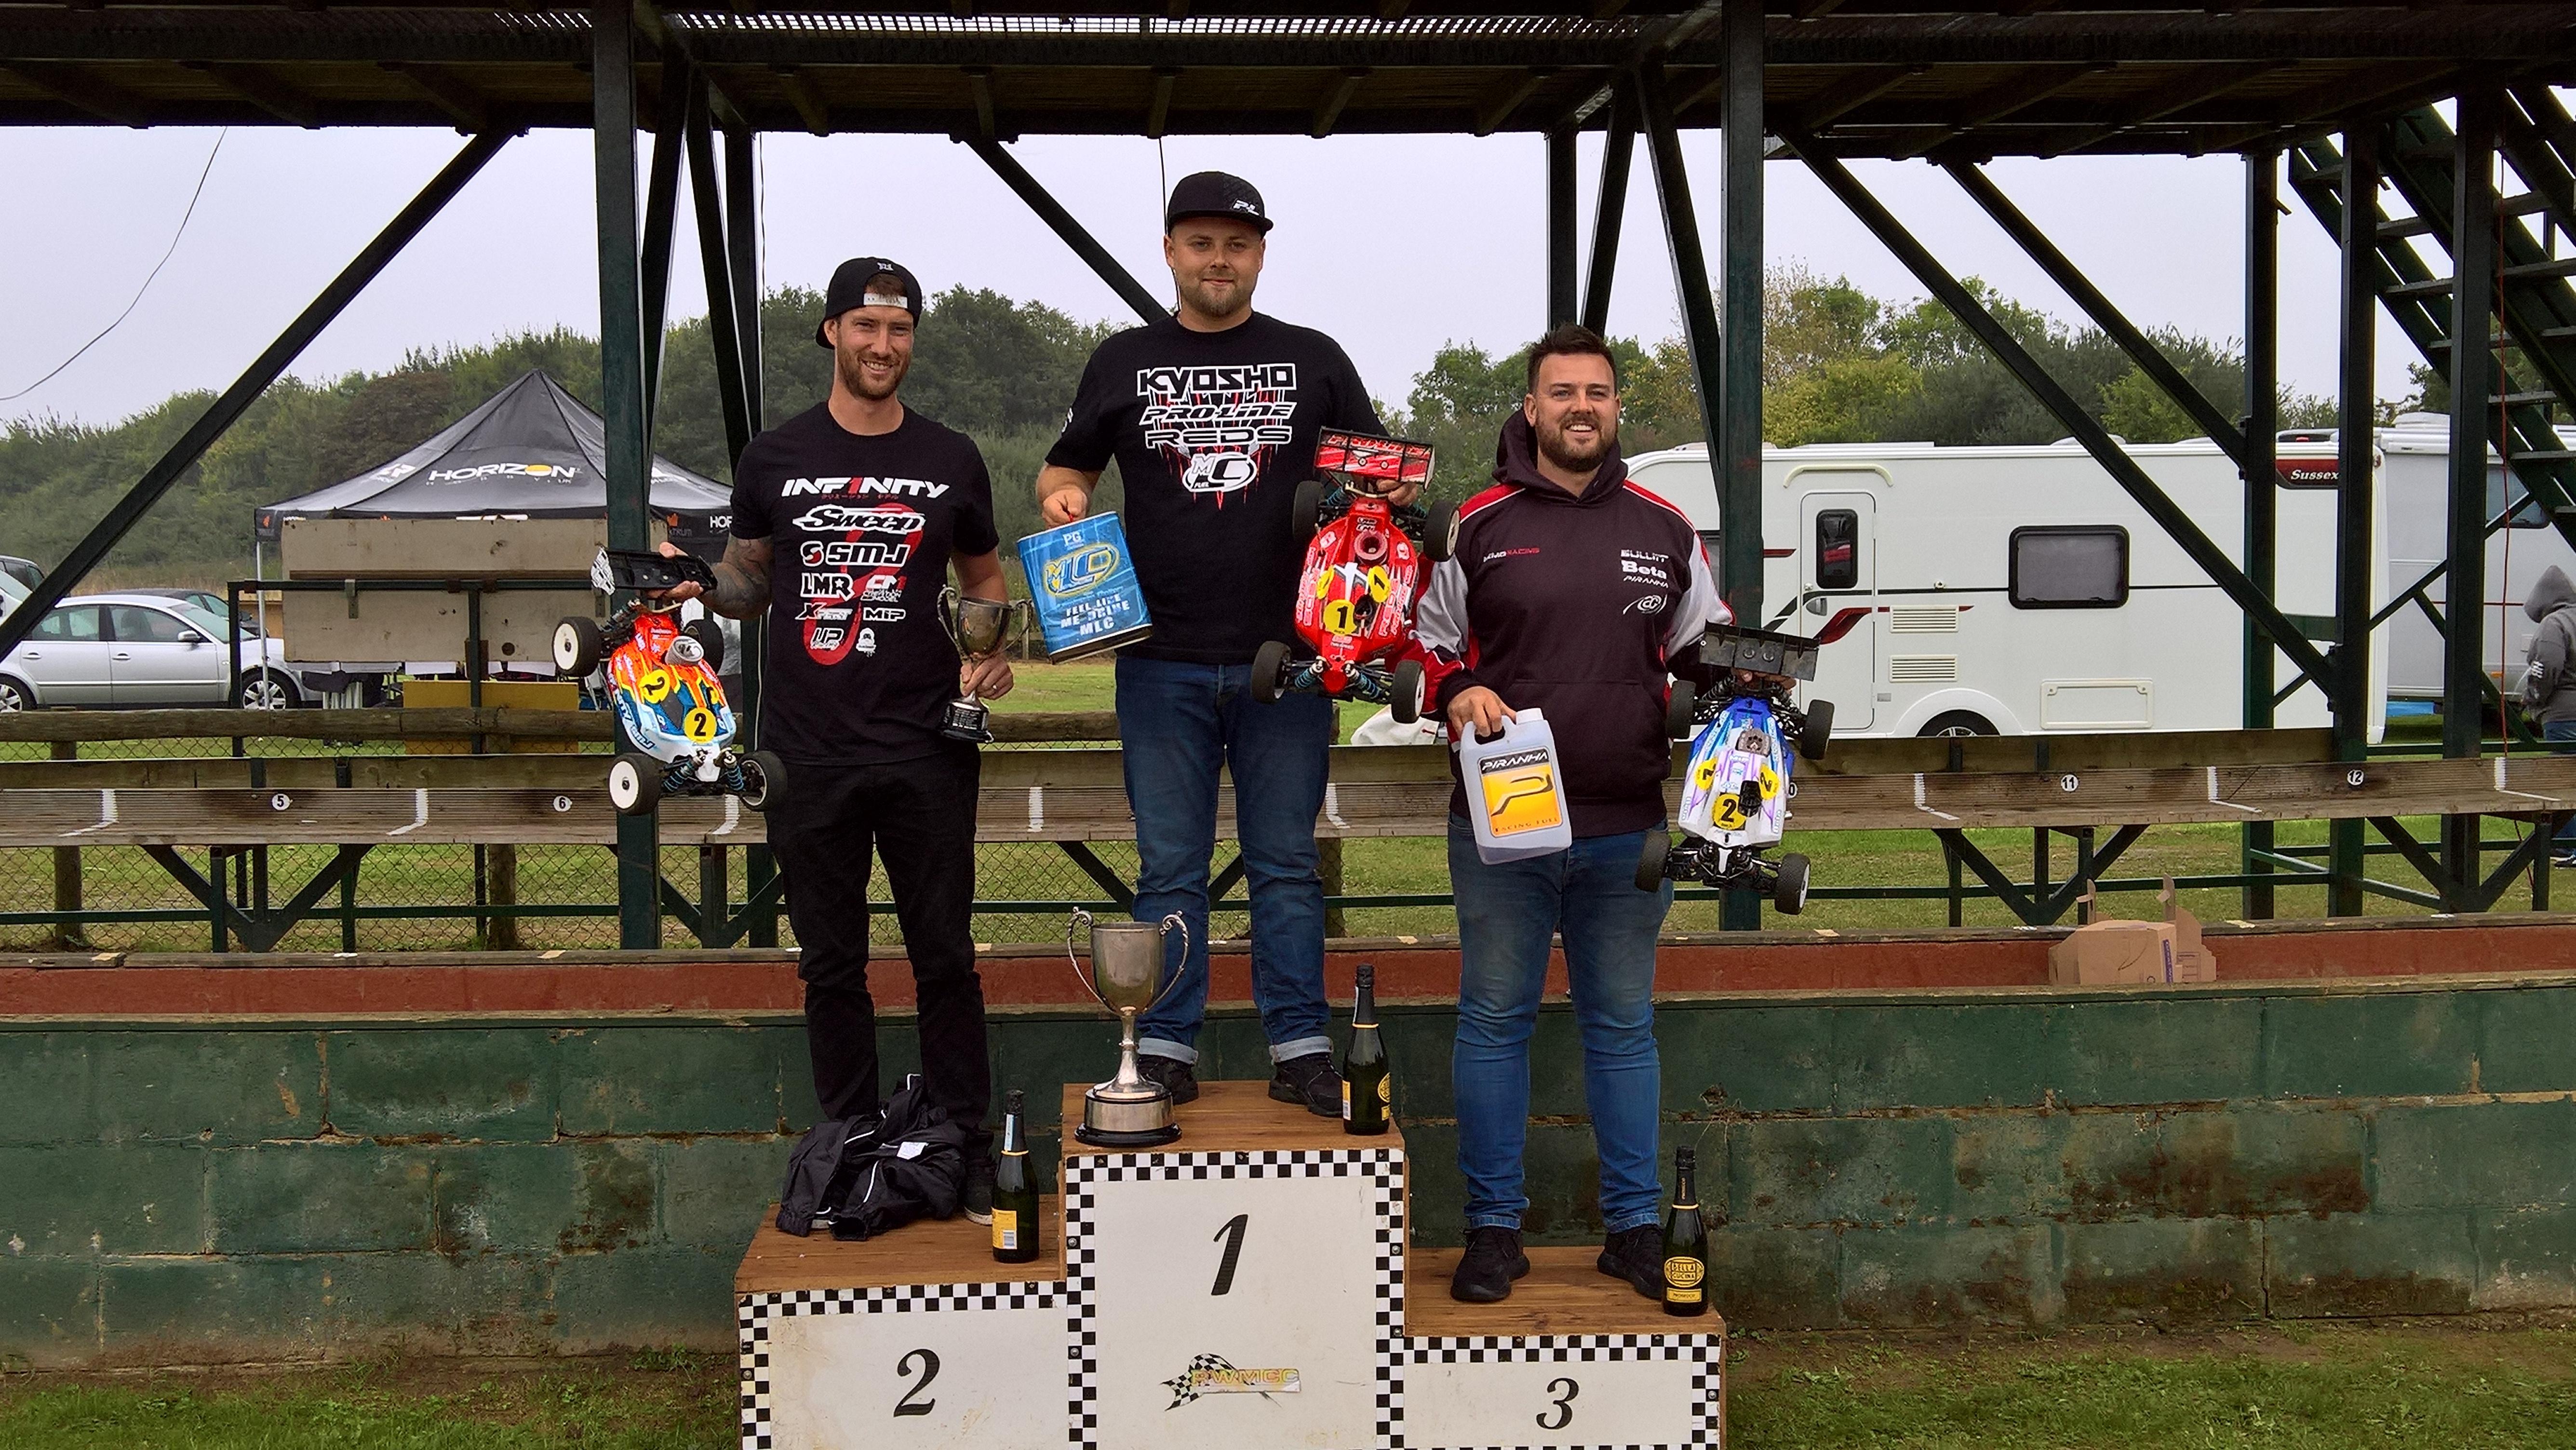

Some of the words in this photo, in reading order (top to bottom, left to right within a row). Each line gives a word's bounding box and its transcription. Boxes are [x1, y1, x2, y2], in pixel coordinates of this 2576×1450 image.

[1137, 363, 1296, 400] KYOSHO
[1145, 426, 1292, 448] REDS
[429, 463, 576, 481] HORIZON
[2290, 469, 2340, 480] Sussex
[781, 477, 949, 498] INFINITY
[826, 542, 911, 567] SMJ
[801, 573, 855, 601] LMR
[1623, 575, 1668, 588] PIRANHA
[1066, 603, 1091, 617] FEEL
[1337, 606, 1348, 629] 1
[1061, 615, 1080, 628] ME
[1080, 616, 1114, 636] MLC
[811, 628, 844, 646] UP
[694, 713, 707, 737] 2
[1482, 751, 1548, 771] PIRANHA
[2062, 777, 2074, 789] 11
[2349, 771, 2362, 782] 12
[1788, 784, 1795, 796] 0
[277, 795, 284, 807] 5
[559, 797, 566, 809] 6
[1720, 799, 1736, 822] 2
[1211, 1215, 1248, 1295] 1
[894, 1349, 939, 1417] 2
[1537, 1378, 1579, 1429] 3
